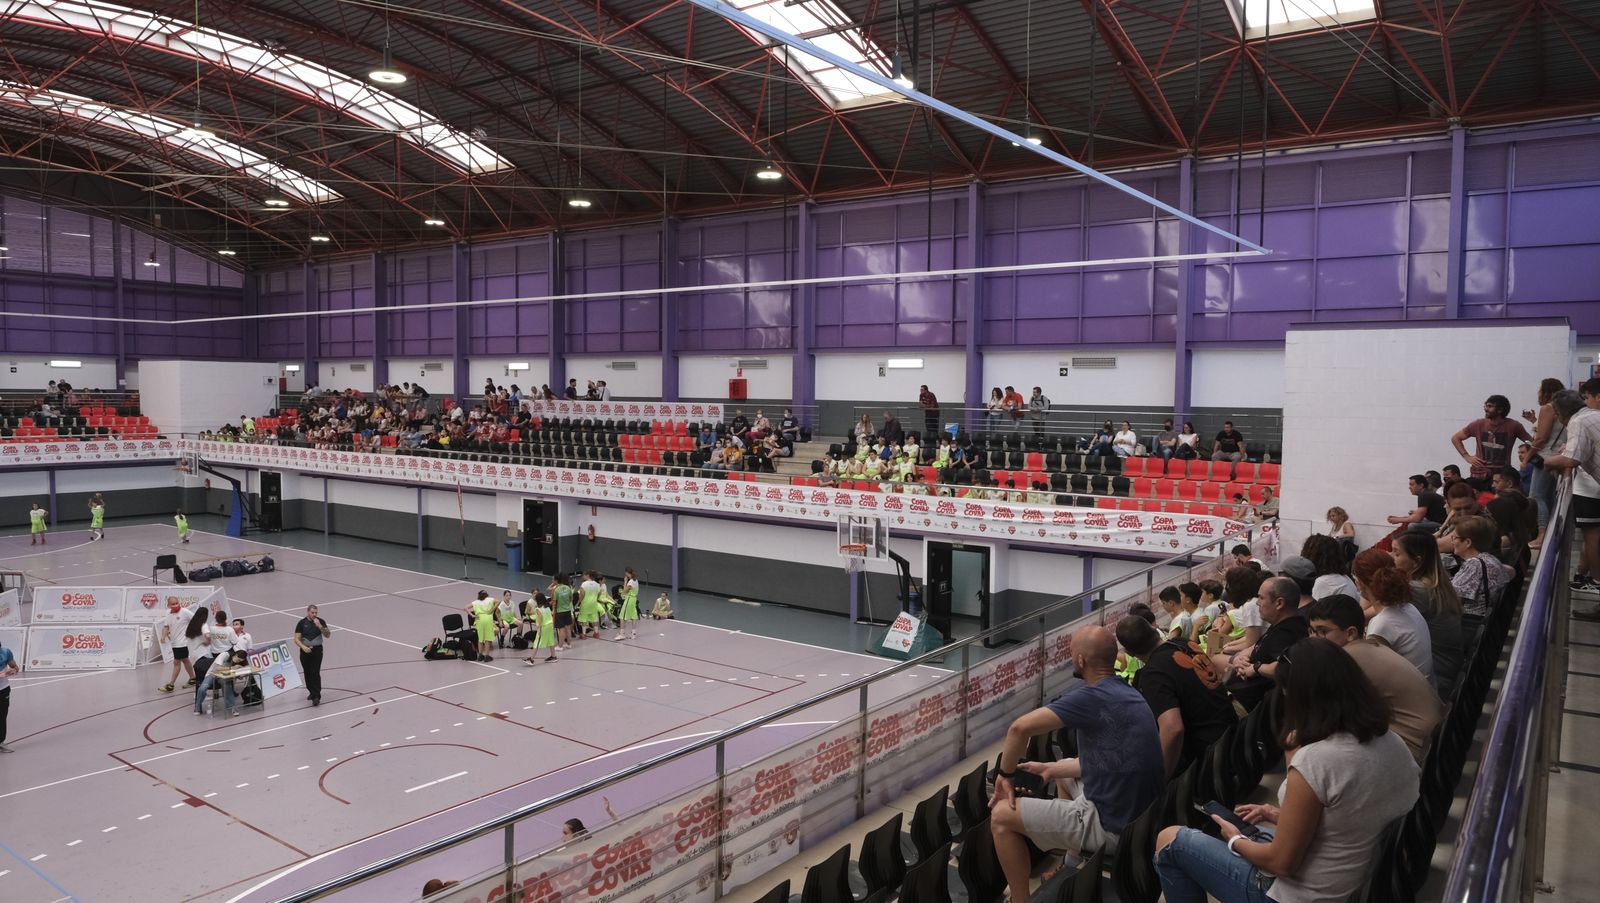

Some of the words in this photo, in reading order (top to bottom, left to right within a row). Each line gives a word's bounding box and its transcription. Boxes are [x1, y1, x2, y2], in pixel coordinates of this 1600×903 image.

[1154, 516, 1174, 524] COPA
[1186, 526, 1213, 534] COVAP
[1189, 519, 1210, 527] COPA
[959, 676, 981, 697] CPA
[919, 694, 943, 716] COPA
[871, 713, 900, 738] COPA
[915, 708, 946, 734] COVAP
[816, 736, 848, 763] COPA
[866, 728, 903, 757] COVAP
[755, 762, 792, 792] COPA
[812, 751, 853, 784] COVAP
[750, 778, 797, 815] COVAP
[591, 831, 646, 869] COPA
[588, 848, 652, 896] COVAP
